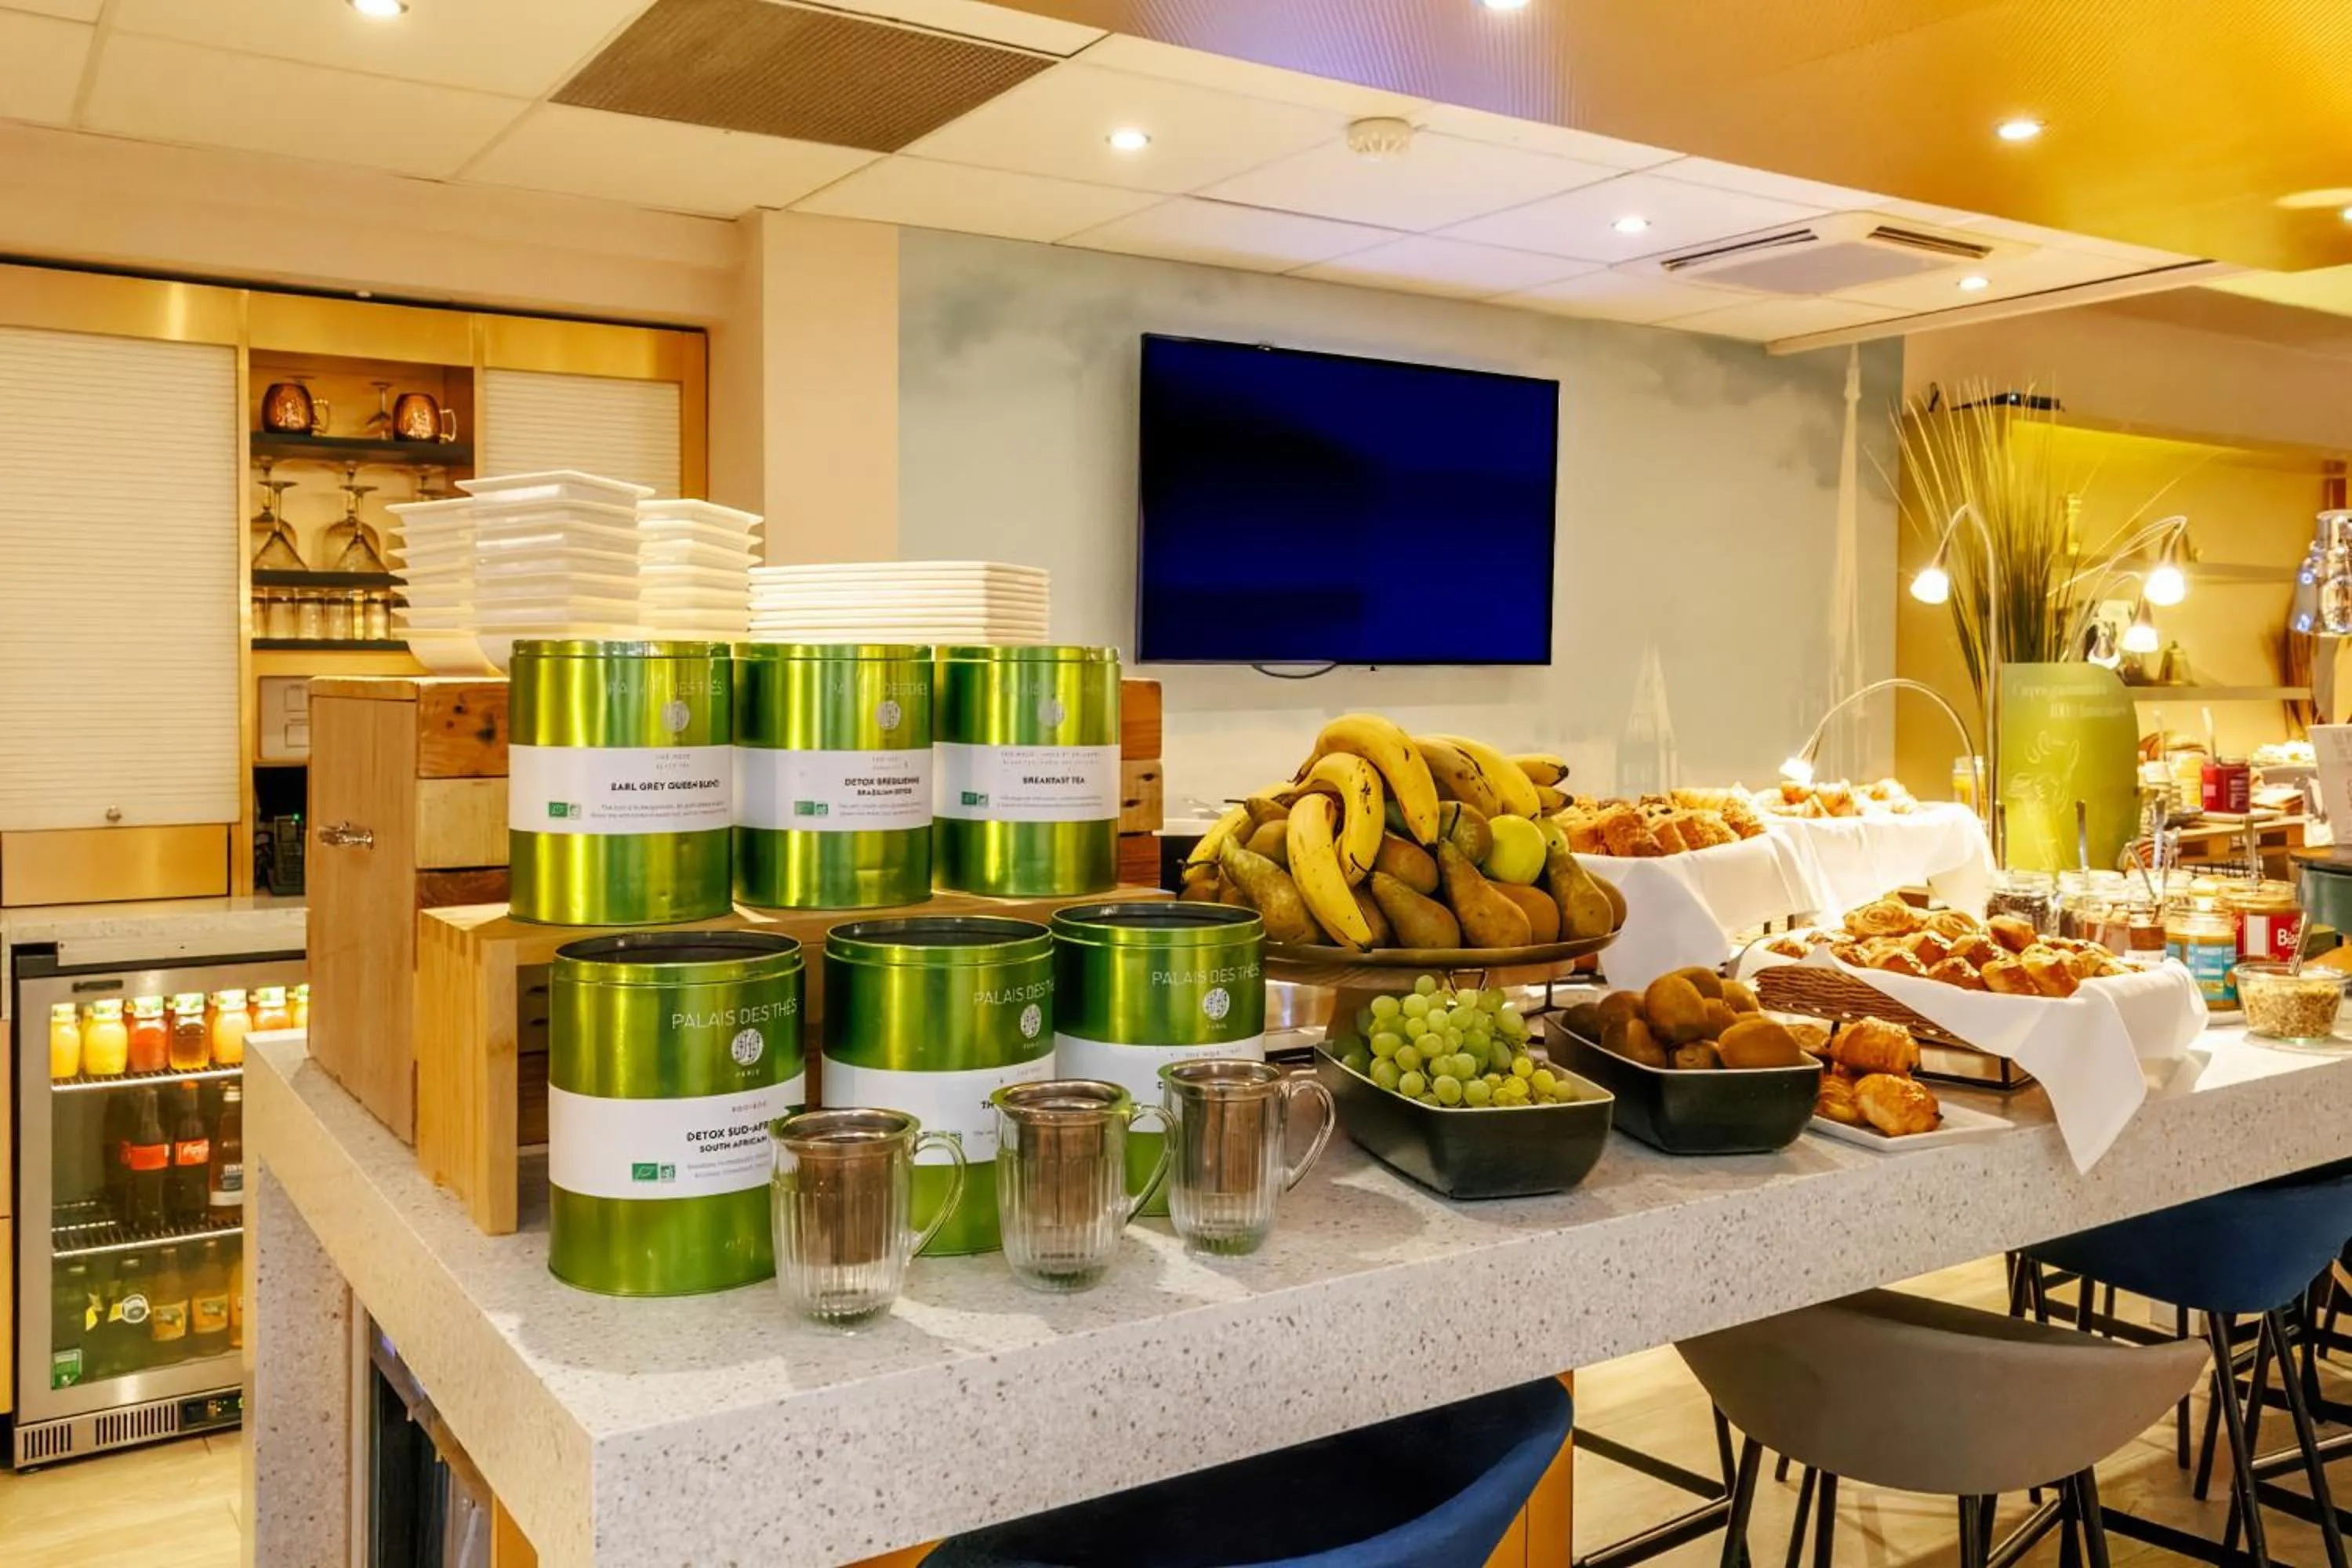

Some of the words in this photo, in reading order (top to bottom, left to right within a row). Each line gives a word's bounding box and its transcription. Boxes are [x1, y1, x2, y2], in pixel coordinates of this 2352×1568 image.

[611, 782, 637, 791] EARL
[639, 782, 666, 791] GREY
[844, 777, 874, 786] DETOX
[1022, 776, 1069, 785] BREAKFAST
[1072, 776, 1085, 785] TEA
[1152, 969, 1207, 987] PALAIS
[1210, 967, 1236, 983] DES
[974, 986, 1024, 1004] PALAIS
[1026, 982, 1045, 1000] DES
[672, 1008, 736, 1029] PALAIS
[739, 1004, 770, 1025] DES
[772, 996, 797, 1019] THÉS
[687, 1128, 725, 1142] DETOX
[728, 1120, 772, 1138] SUD-AFR
[699, 1142, 731, 1153] SOUTH
[732, 1134, 768, 1149] AFRICAN
